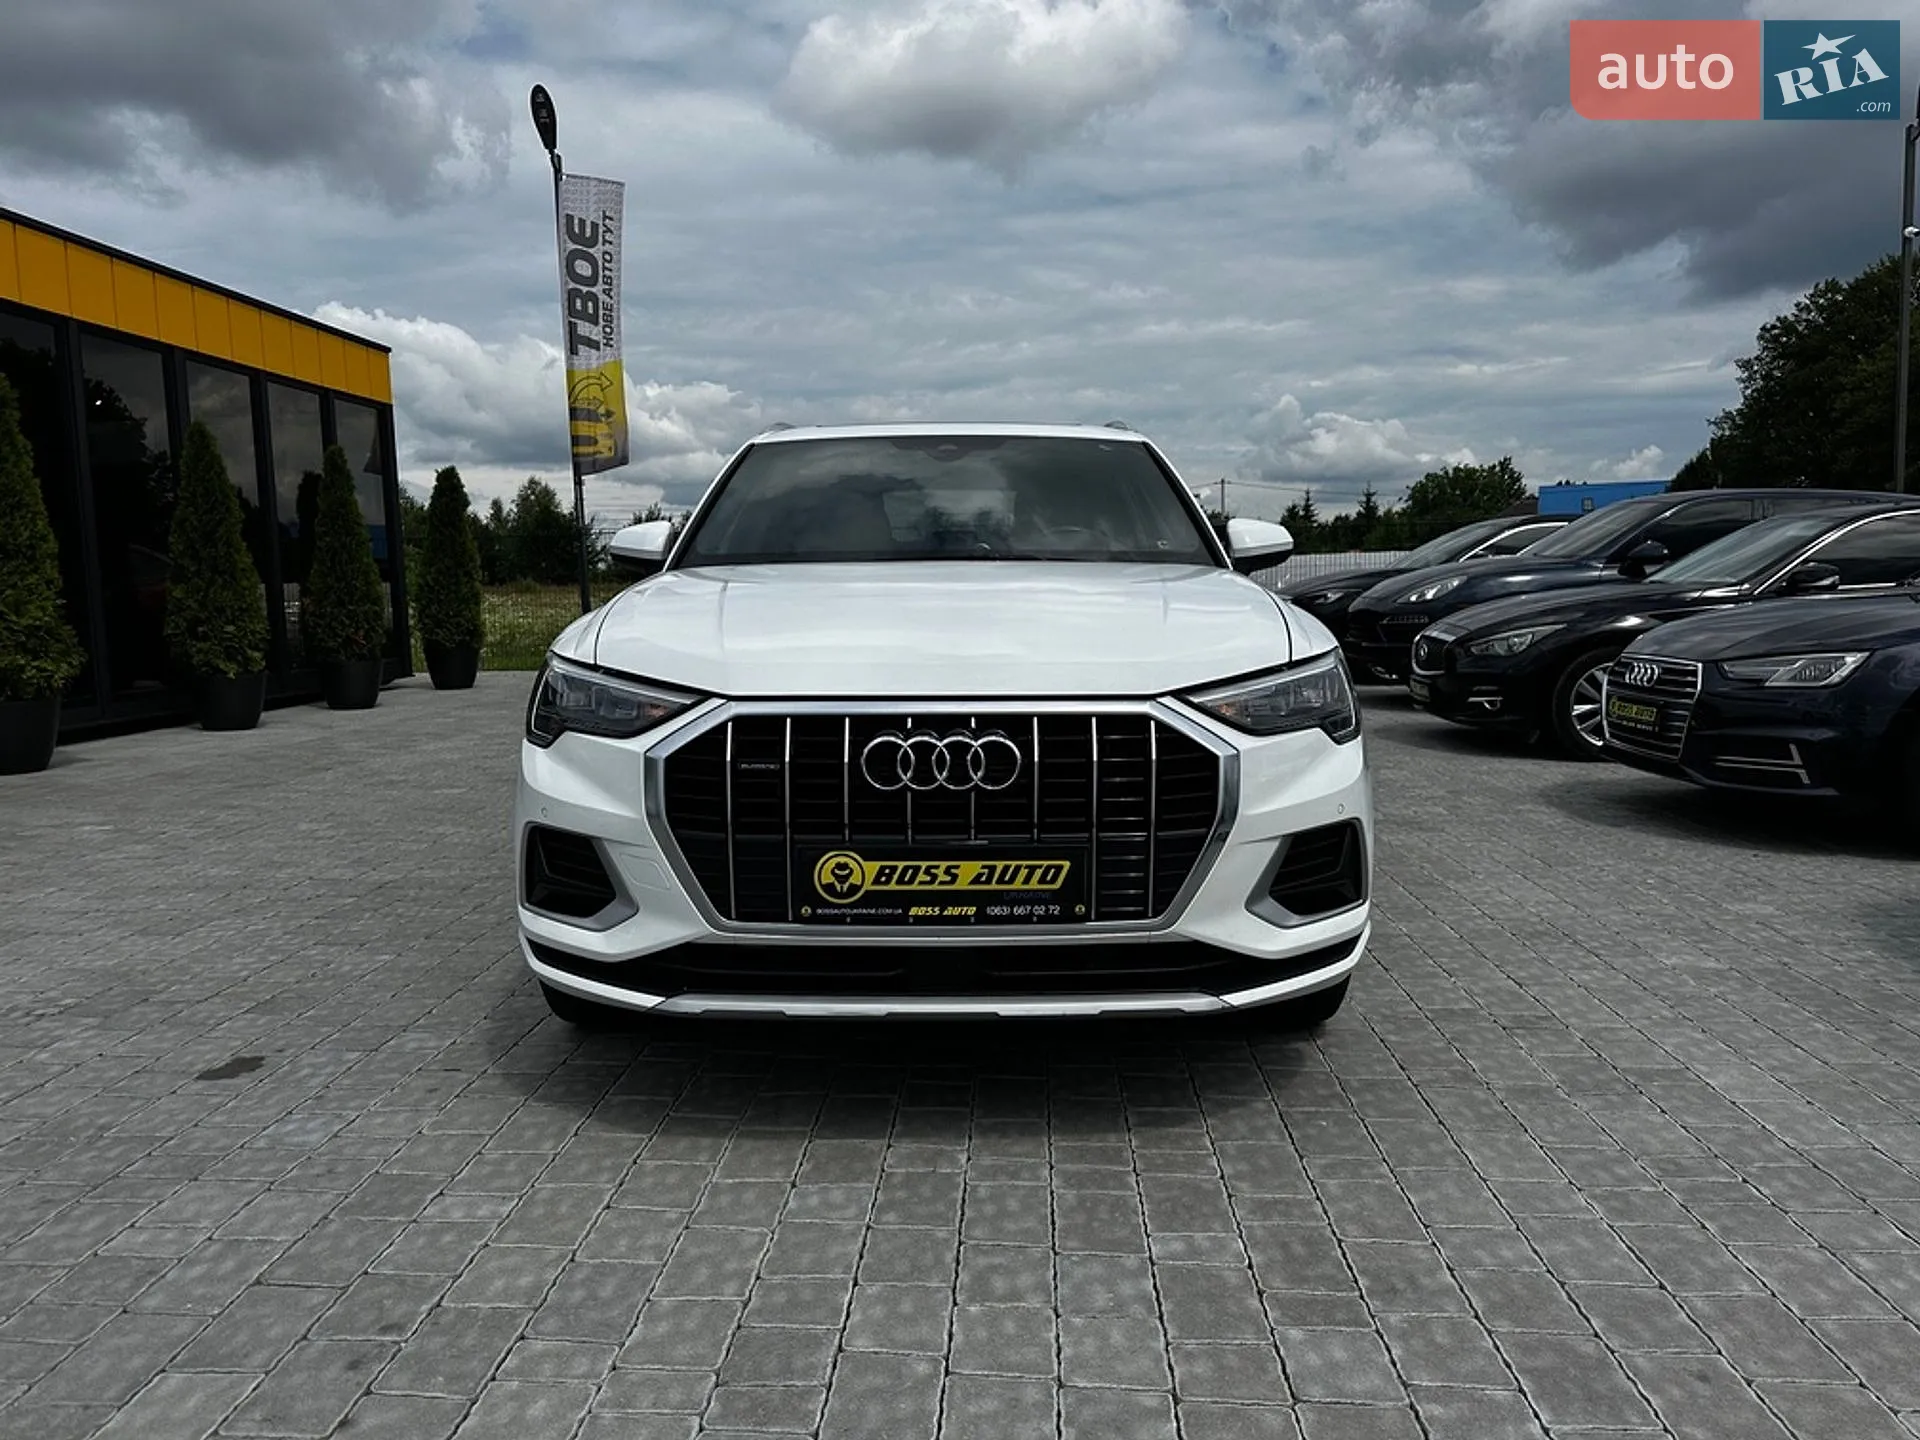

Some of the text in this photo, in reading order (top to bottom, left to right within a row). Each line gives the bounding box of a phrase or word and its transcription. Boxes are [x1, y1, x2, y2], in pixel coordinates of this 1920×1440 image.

[602, 211, 615, 348] НОВЕ АВТО ТУТ
[871, 865, 1063, 885] BOSS AUTO
[908, 906, 940, 916] BOSS
[942, 906, 977, 916] AUTO
[986, 905, 1011, 916] (063)
[1013, 905, 1032, 916] 667
[1033, 905, 1046, 916] 02
[1048, 905, 1061, 916] 72
